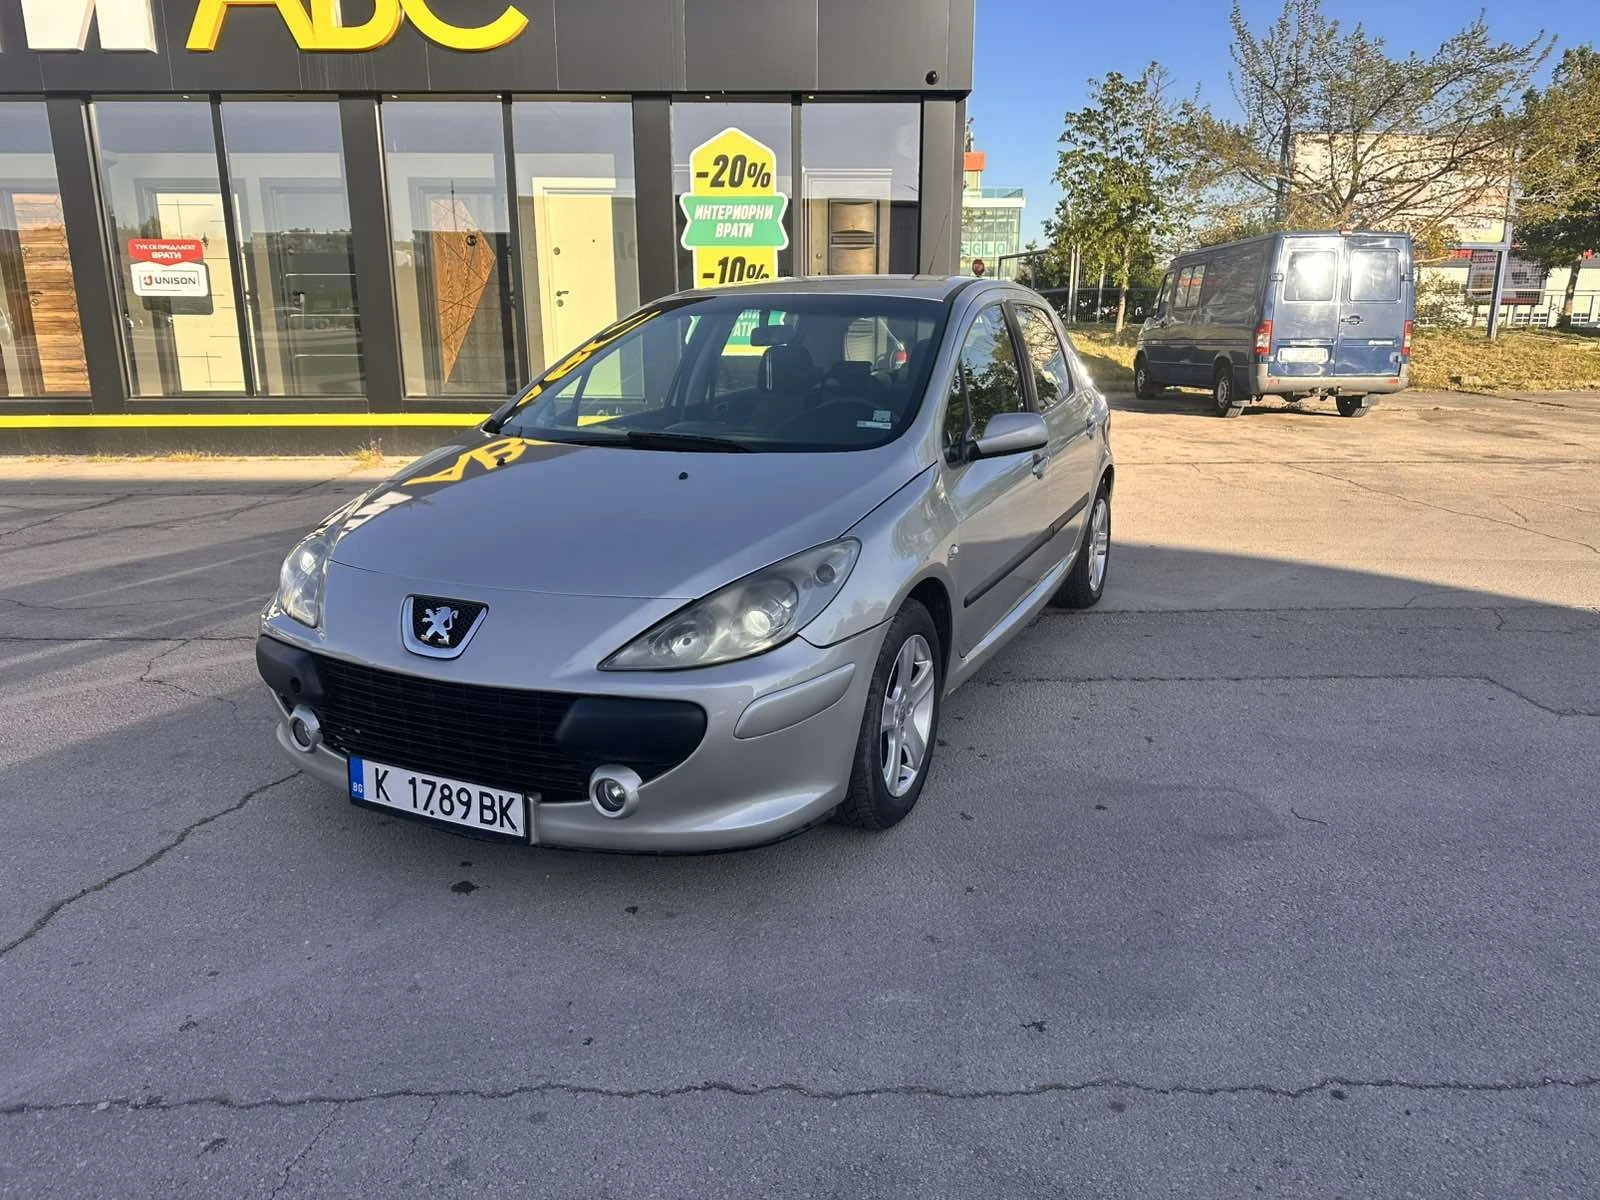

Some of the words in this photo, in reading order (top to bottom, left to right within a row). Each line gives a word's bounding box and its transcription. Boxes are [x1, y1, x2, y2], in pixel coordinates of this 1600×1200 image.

[695, 154, 771, 188] -20%
[694, 204, 774, 220] ИНТЕРИОРНИ
[715, 222, 754, 238] ВРАТИ
[151, 251, 182, 259] ВРАТИ
[155, 276, 196, 285] UNISON
[352, 782, 364, 793] BG
[374, 767, 391, 801] K
